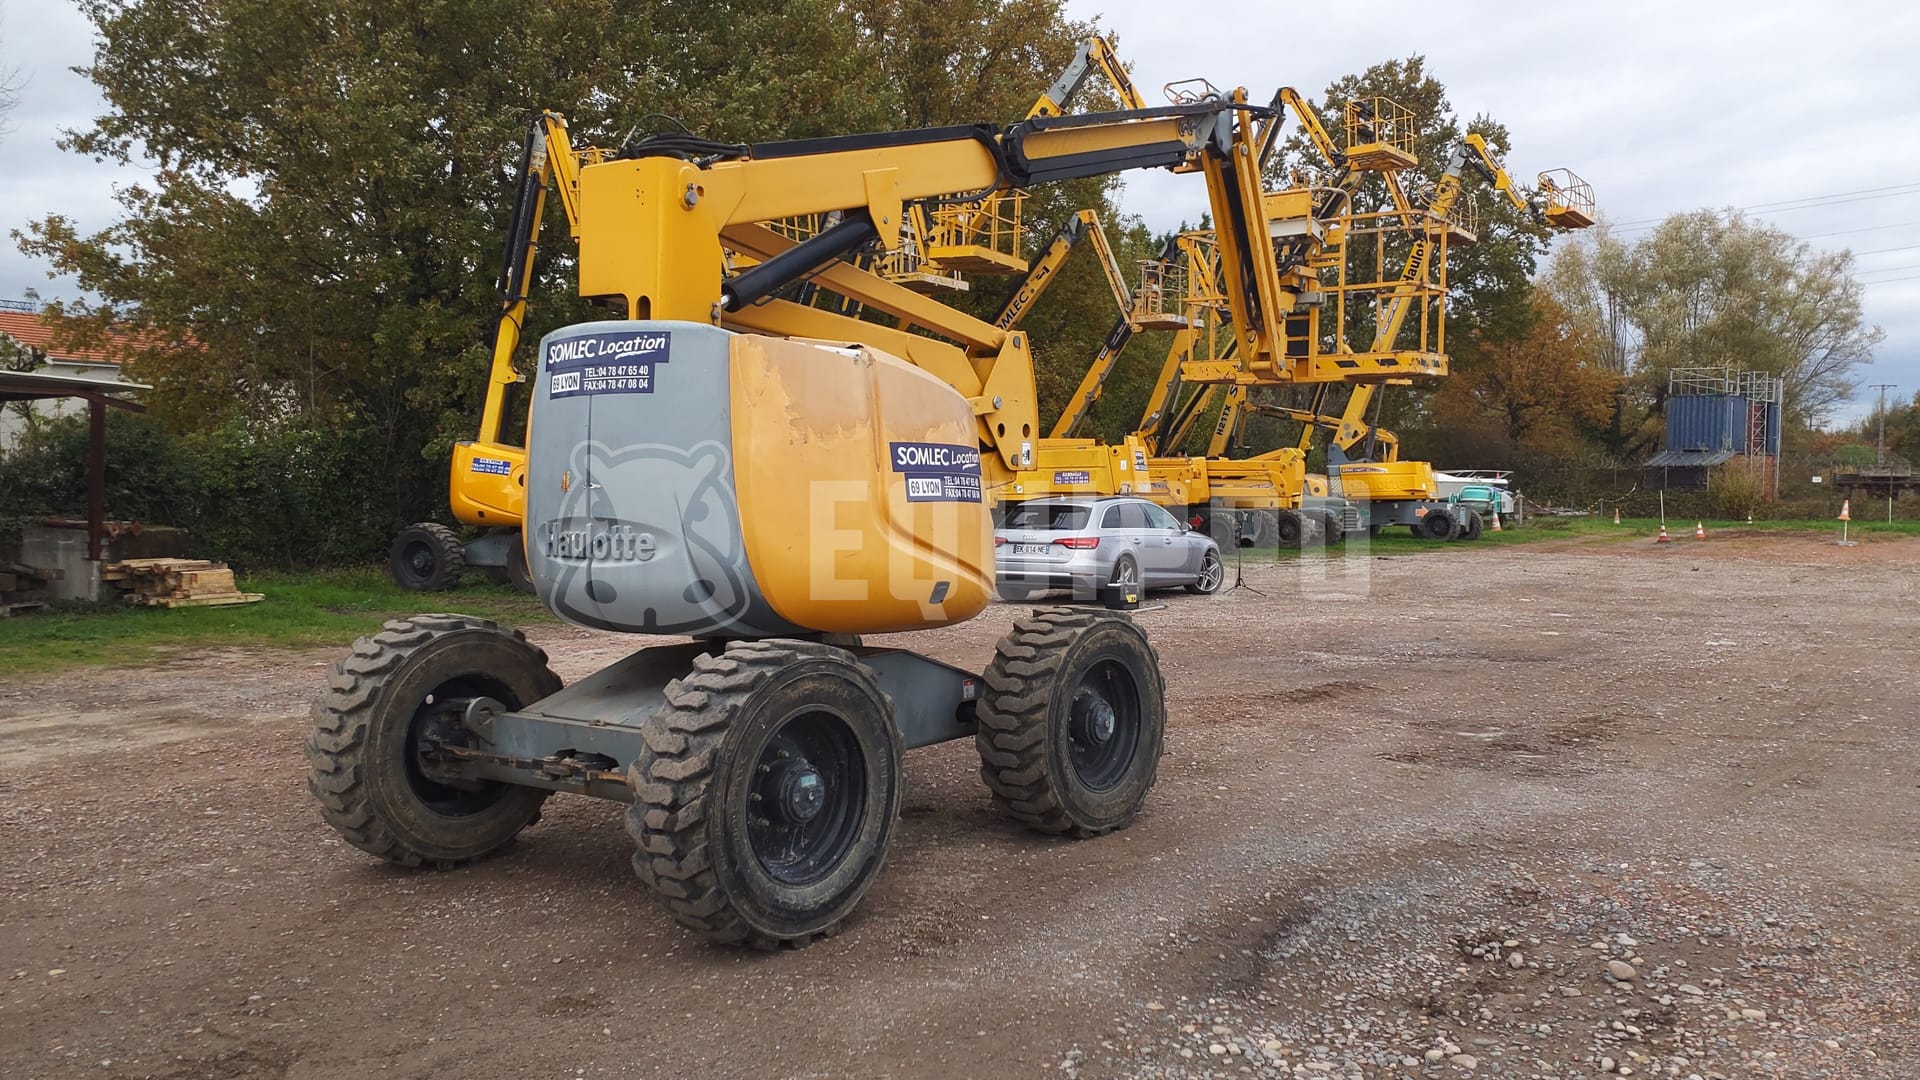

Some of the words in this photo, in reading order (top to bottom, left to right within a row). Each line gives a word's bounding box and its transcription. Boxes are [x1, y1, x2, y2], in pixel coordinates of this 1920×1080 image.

[548, 339, 597, 364] SOMLEC
[598, 335, 665, 358] Location
[608, 366, 617, 376] 78
[617, 366, 627, 376] 47
[628, 365, 638, 376] 65
[639, 365, 649, 376] 40
[561, 374, 579, 389] LYON
[608, 380, 616, 390] 78
[617, 380, 627, 389] 47
[628, 379, 637, 389] 08
[639, 378, 648, 389] 04
[897, 446, 950, 466] SOMLEC
[911, 481, 920, 494] 69
[921, 482, 940, 494] LYON
[545, 521, 656, 561] Haulotte
